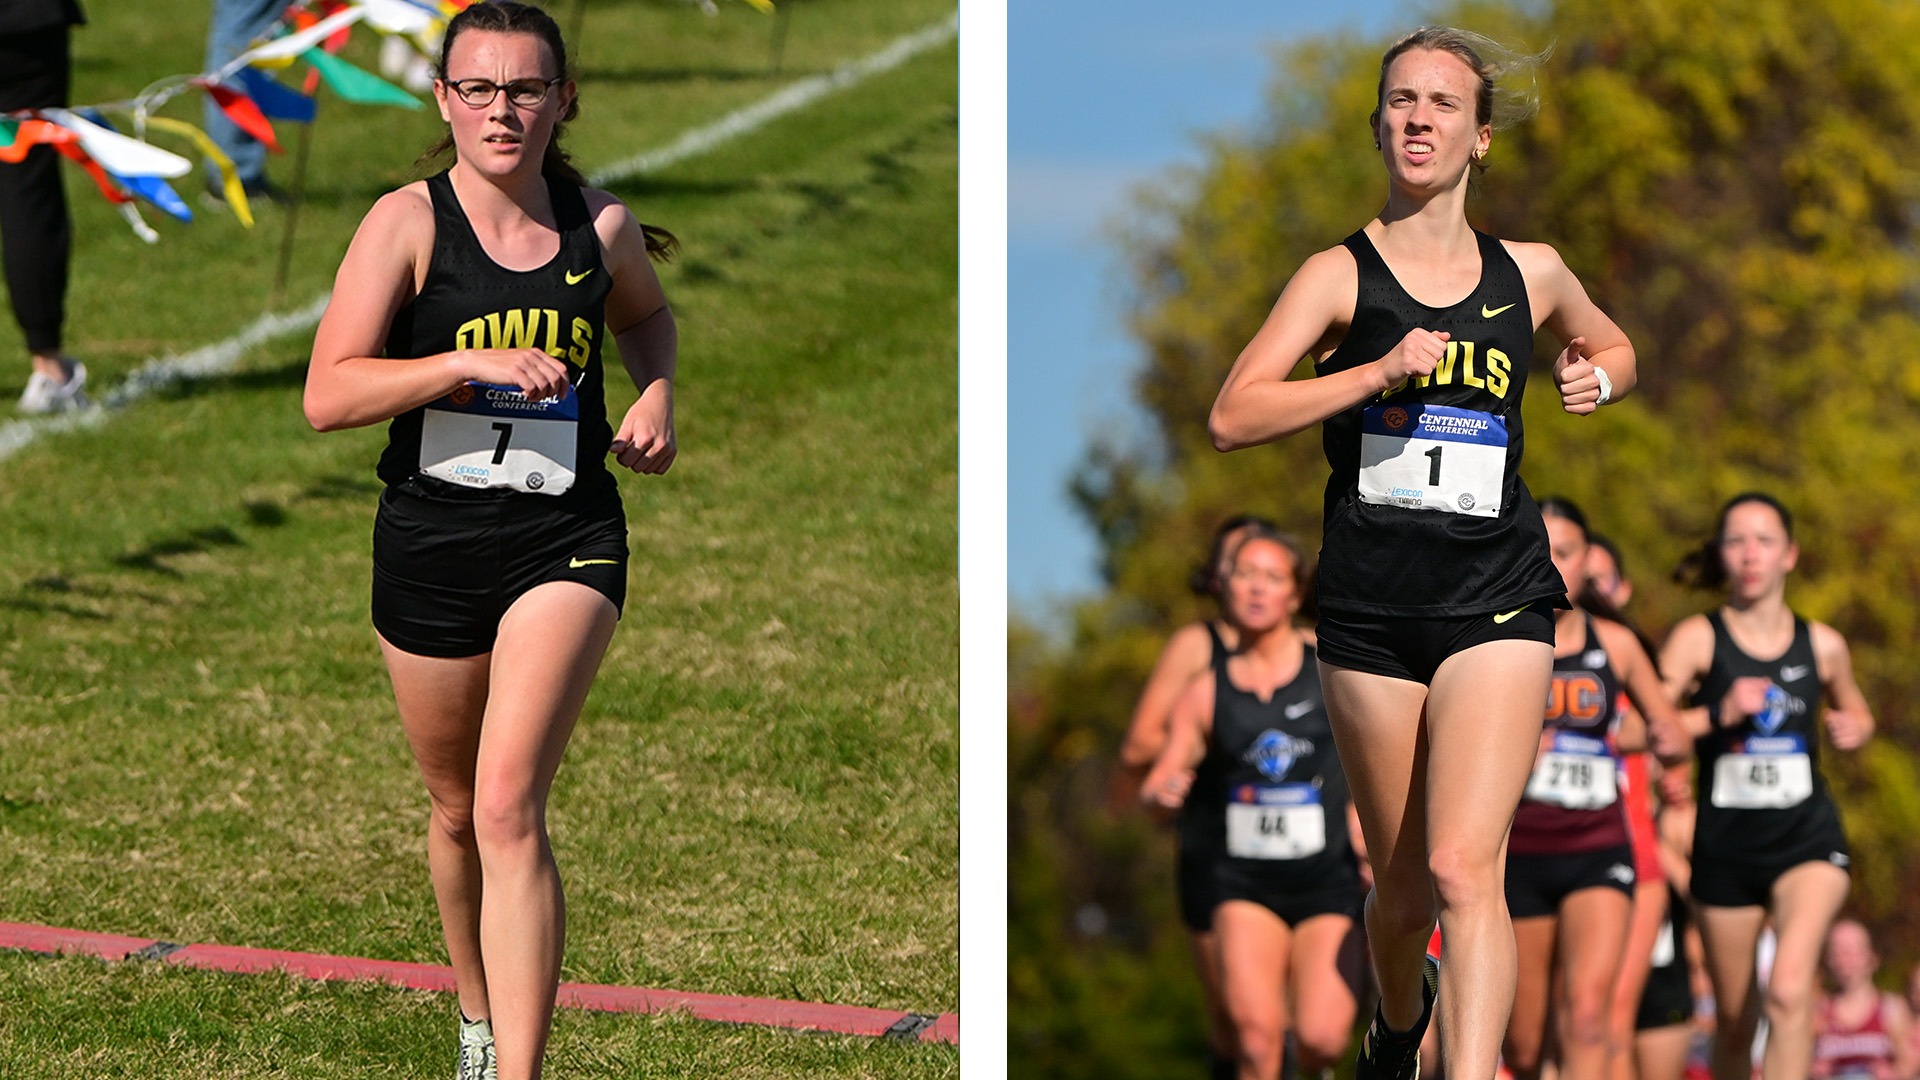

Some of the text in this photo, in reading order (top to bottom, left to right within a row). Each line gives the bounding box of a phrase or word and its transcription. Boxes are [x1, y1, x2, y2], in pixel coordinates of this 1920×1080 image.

[456, 308, 593, 369] OWLS
[492, 401, 547, 411] CONFERENCE
[1418, 413, 1488, 430] CENTENNIAL
[1424, 424, 1478, 436] CONFERENCE
[491, 422, 513, 465] 7
[1424, 445, 1442, 487] 1
